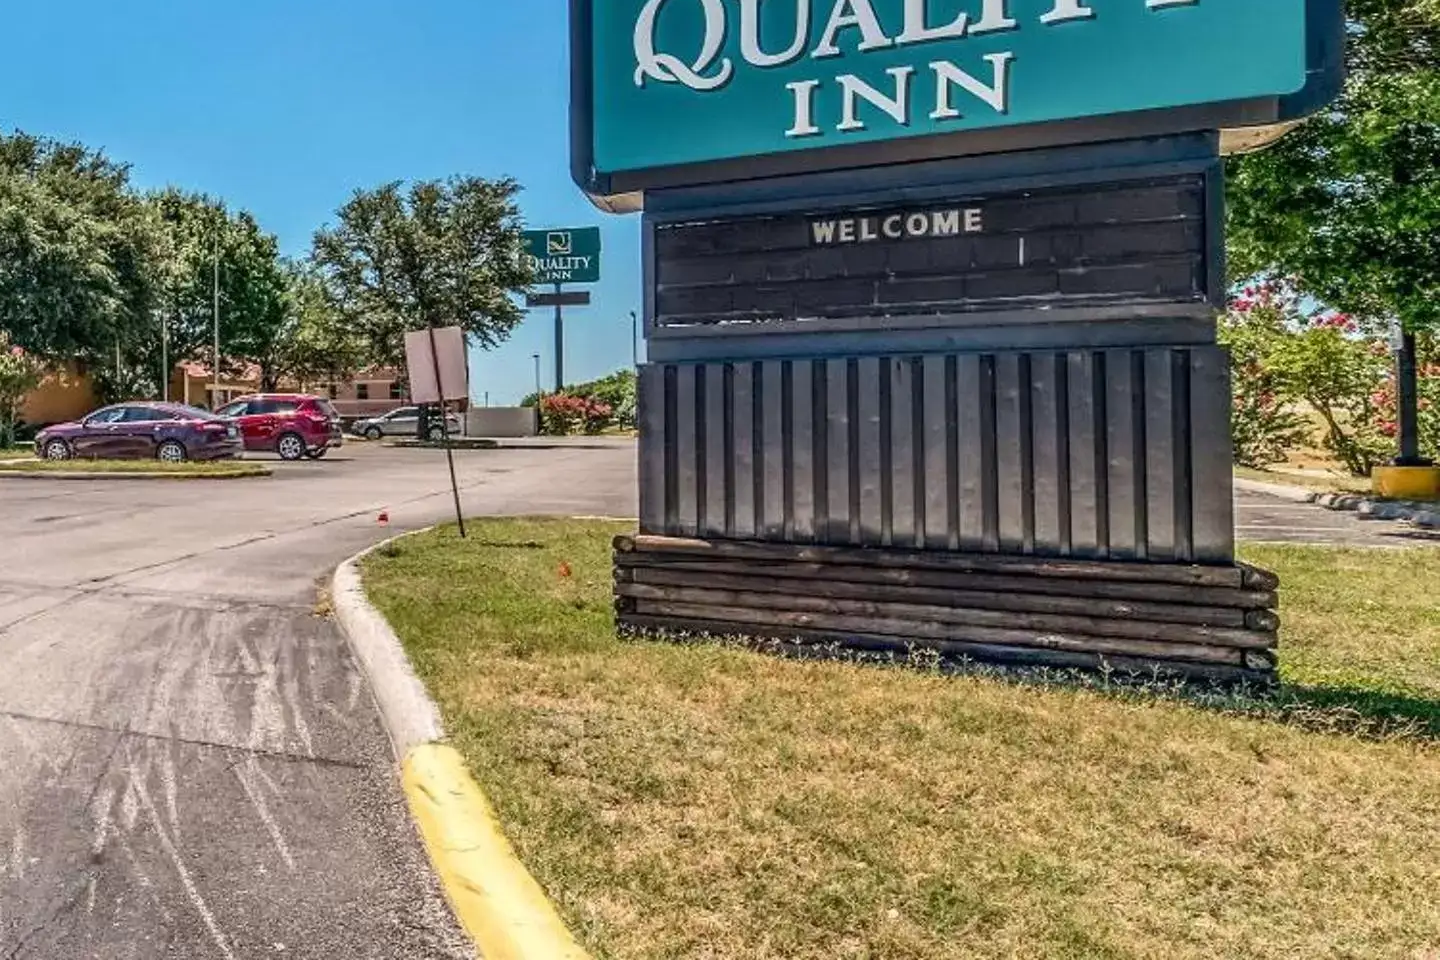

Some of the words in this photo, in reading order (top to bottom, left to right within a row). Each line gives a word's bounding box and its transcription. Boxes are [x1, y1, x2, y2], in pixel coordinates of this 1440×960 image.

[784, 51, 1012, 136] INN
[812, 208, 982, 243] WELCOME
[546, 271, 572, 279] INN
